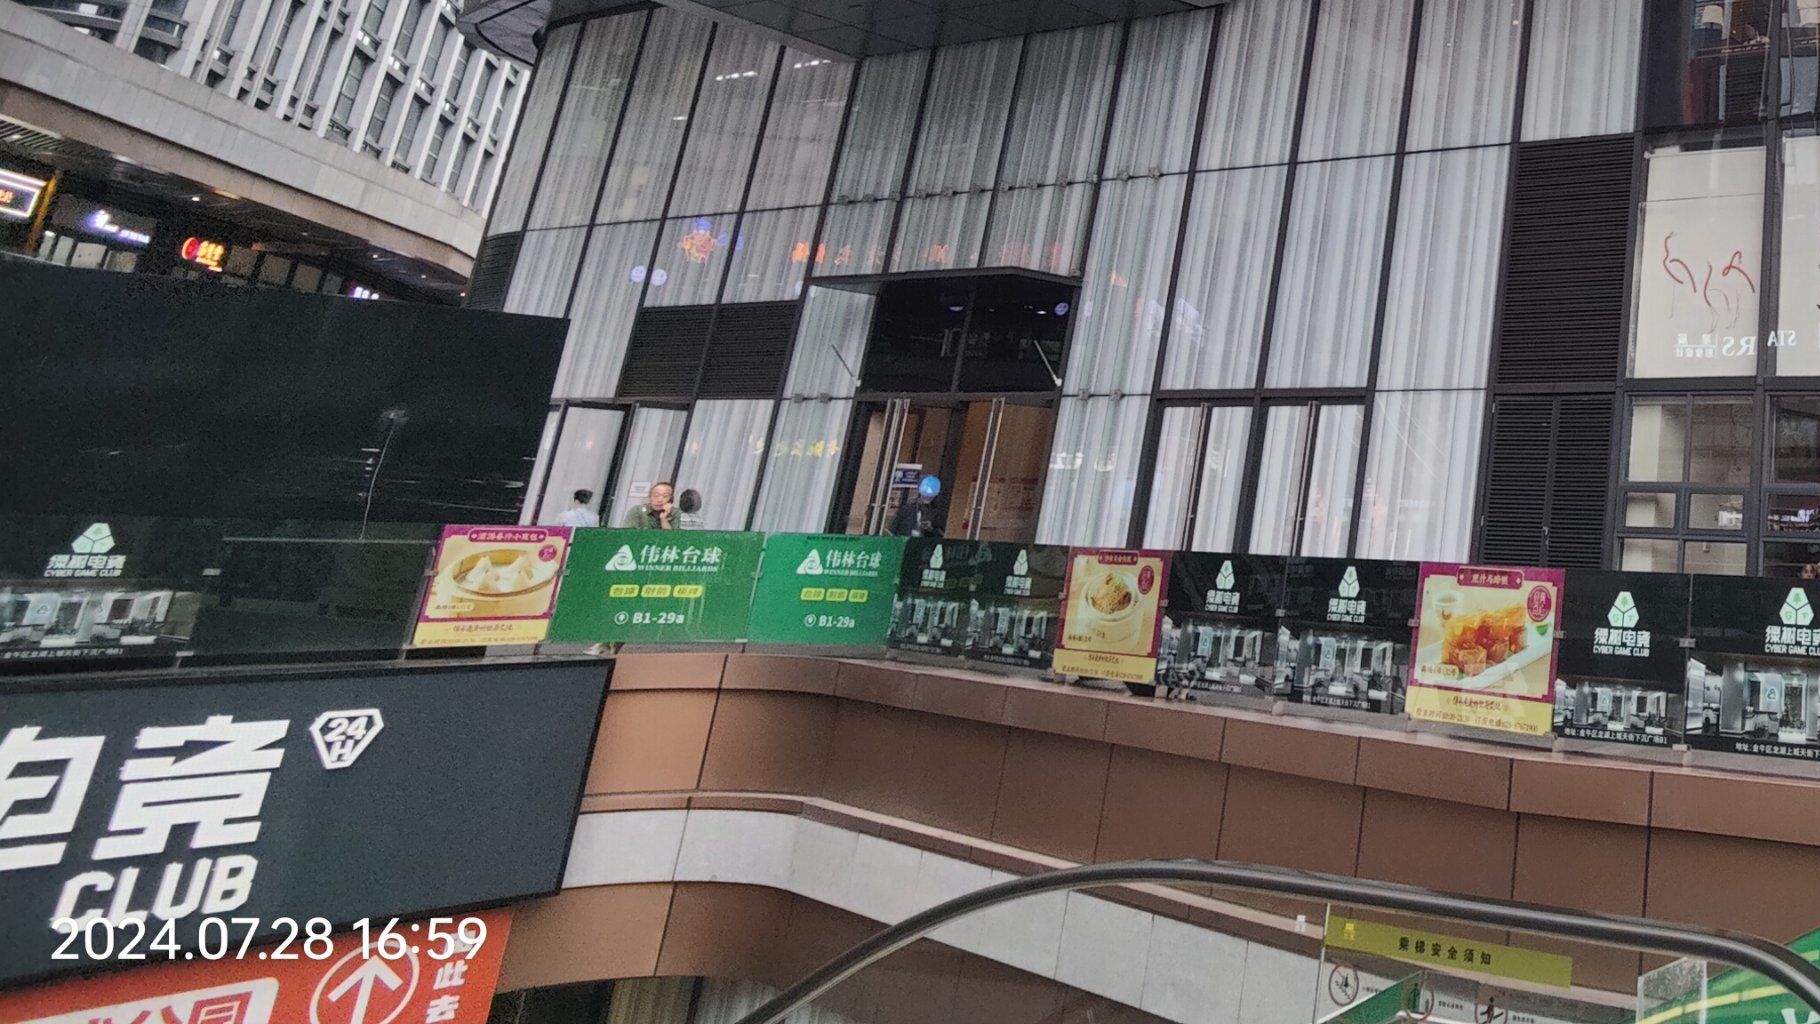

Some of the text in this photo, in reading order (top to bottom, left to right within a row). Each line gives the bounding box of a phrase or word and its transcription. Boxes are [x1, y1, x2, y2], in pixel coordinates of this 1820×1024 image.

[639, 544, 723, 564] 伟林台球
[825, 549, 883, 569] 伟林台球
[632, 611, 685, 625] B1-29a
[1593, 645, 1650, 657] CYBER GAME CLUB
[1764, 644, 1788, 655] CYBER
[1788, 645, 1807, 656] GAME
[49, 854, 259, 934] CLUB
